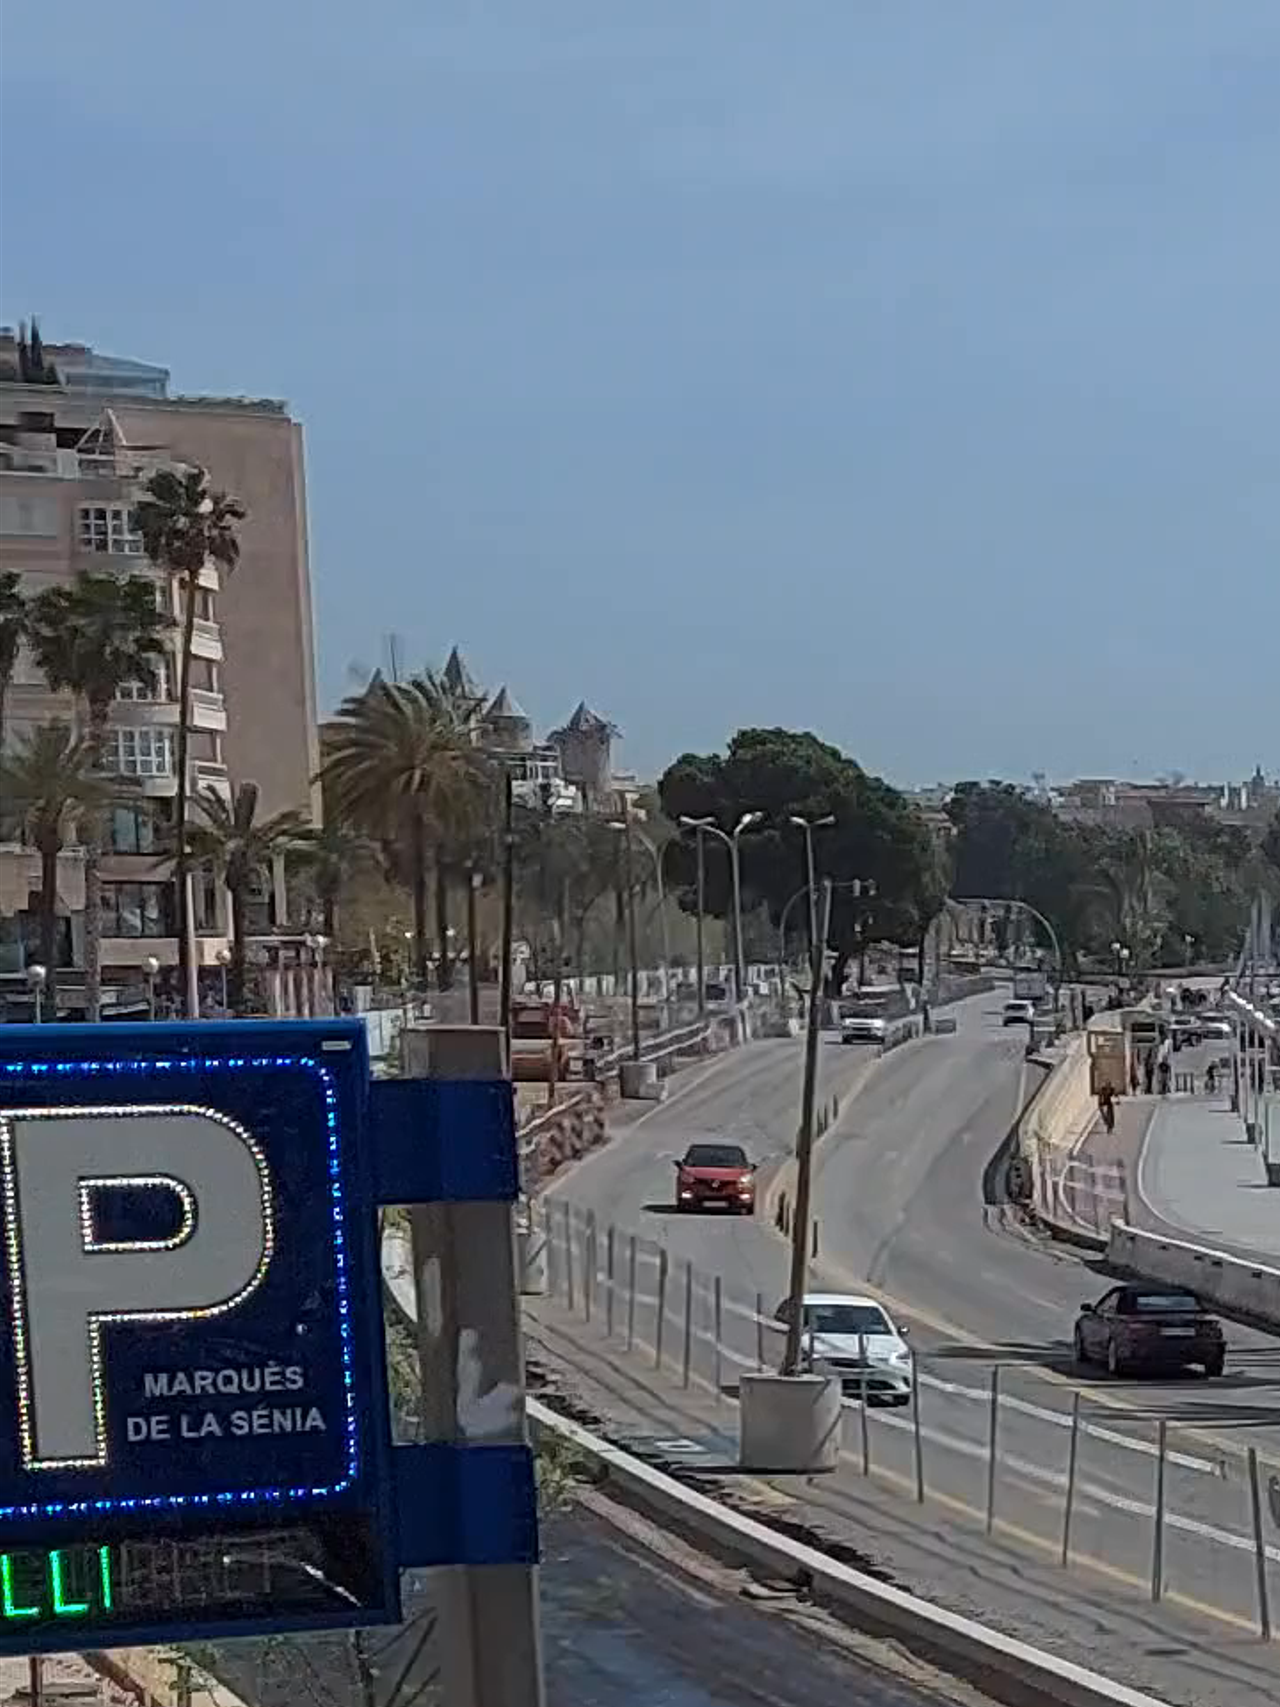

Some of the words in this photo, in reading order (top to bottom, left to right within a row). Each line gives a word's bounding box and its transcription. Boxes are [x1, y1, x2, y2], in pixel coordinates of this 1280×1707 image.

[0, 1105, 274, 1471] P
[126, 1415, 171, 1442] DE
[180, 1412, 222, 1438] LA
[230, 1403, 327, 1435] SÉNIA
